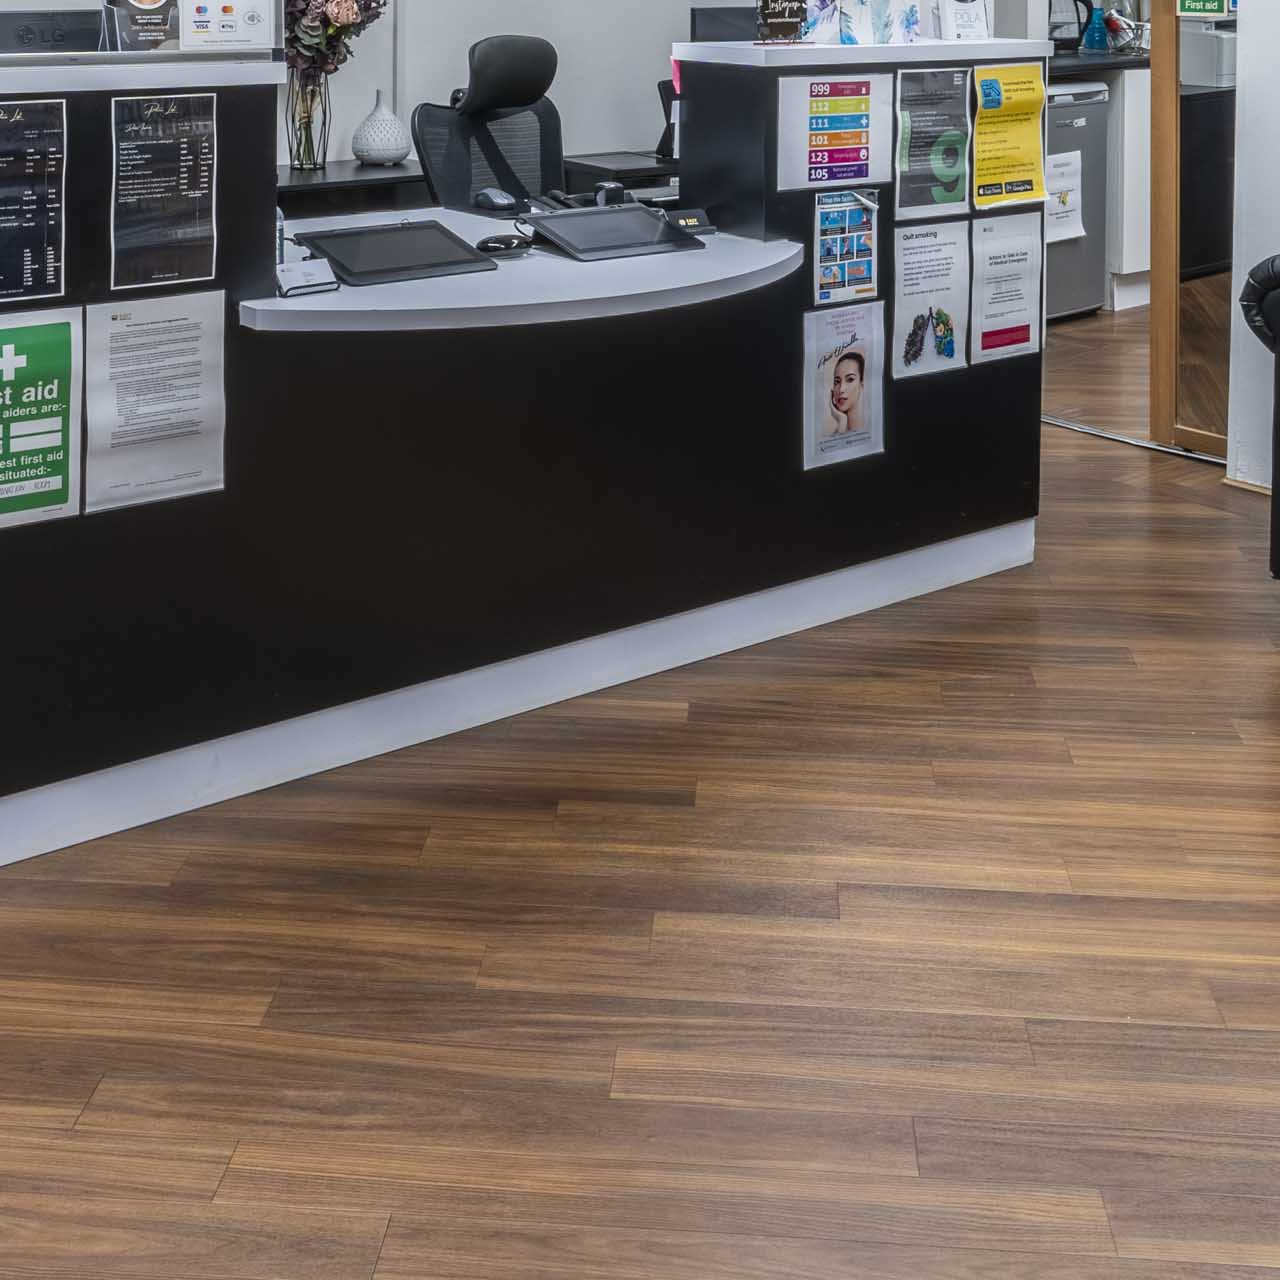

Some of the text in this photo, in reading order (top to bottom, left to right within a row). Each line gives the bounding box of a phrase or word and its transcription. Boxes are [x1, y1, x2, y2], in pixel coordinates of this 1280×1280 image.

[1185, 1, 1218, 10] First aid
[40, 29, 65, 43] LG
[811, 84, 830, 95] 999
[811, 118, 829, 128] 111
[811, 135, 829, 145] 101
[810, 152, 828, 163] 123
[810, 169, 828, 179] 105
[22, 379, 58, 402] aid
[2, 405, 37, 417] aiders
[41, 403, 67, 413] are:-
[20, 454, 43, 466] first
[46, 450, 64, 461] aid
[0, 465, 52, 481] situated:-
